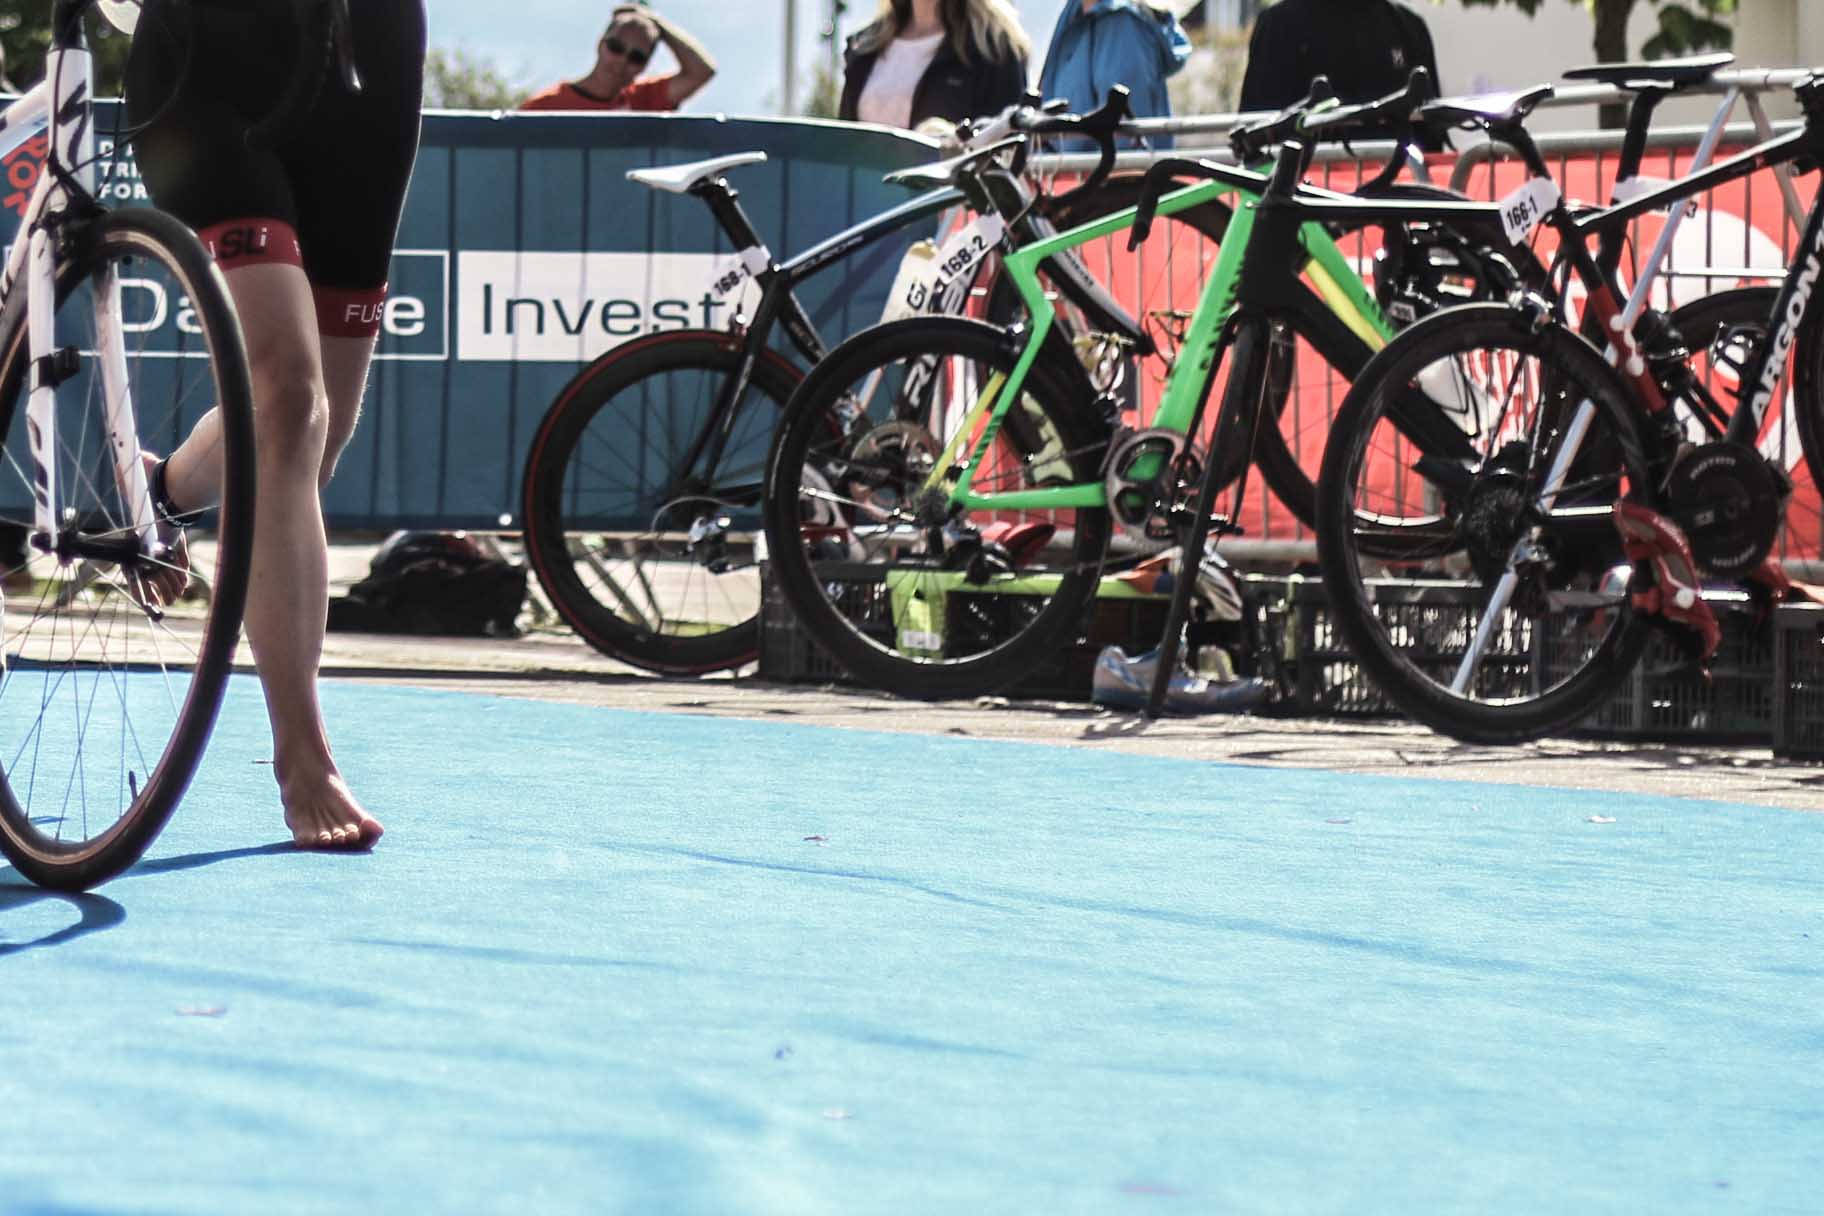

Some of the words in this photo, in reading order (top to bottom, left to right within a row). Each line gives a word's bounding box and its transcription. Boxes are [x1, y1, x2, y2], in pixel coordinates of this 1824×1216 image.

[714, 262, 752, 297] 168-1
[940, 235, 988, 278] 168-2
[114, 278, 426, 336] Dae
[482, 284, 726, 335] Invest
[1751, 254, 1821, 425] ARGON
